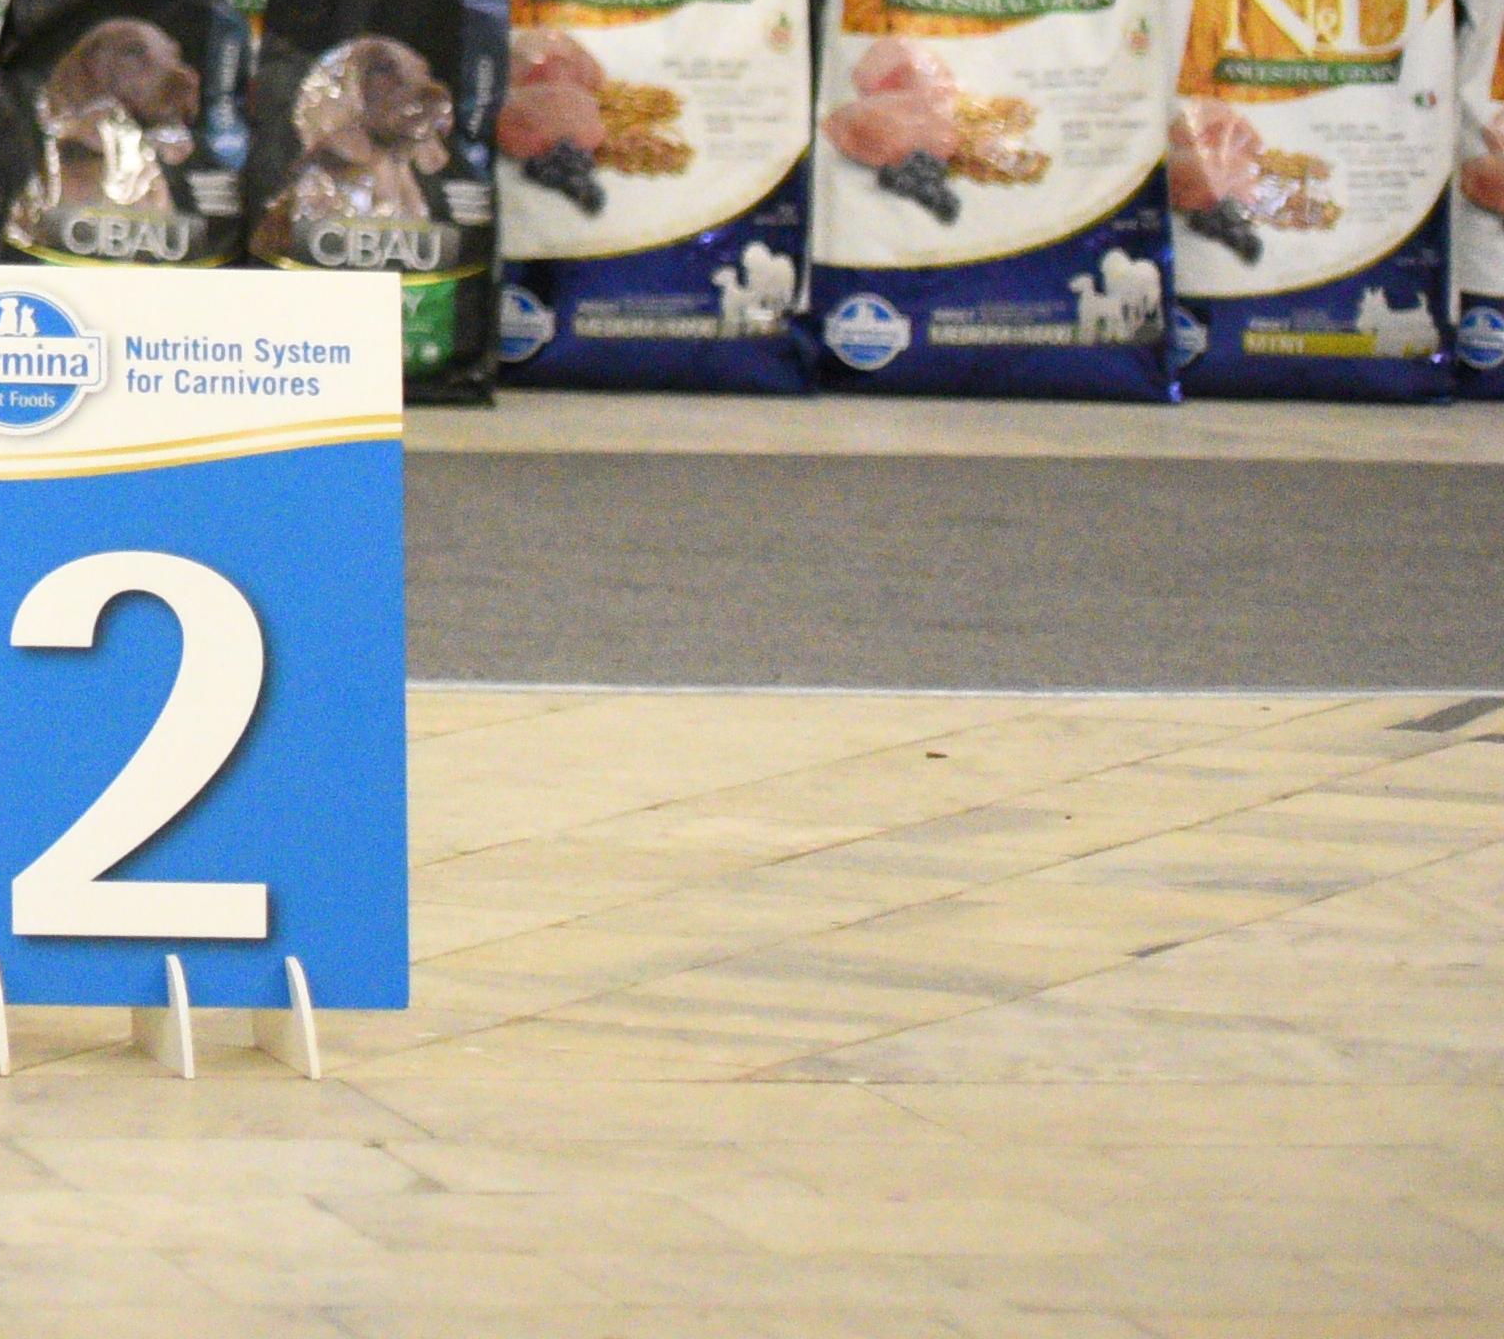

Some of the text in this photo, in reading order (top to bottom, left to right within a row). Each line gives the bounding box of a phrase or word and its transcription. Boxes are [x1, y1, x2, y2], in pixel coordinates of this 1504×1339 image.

[62, 214, 189, 261] CIBAU
[308, 222, 441, 271] CIBAU
[125, 335, 351, 369] Nutrition System
[10, 391, 56, 408] Foods
[126, 368, 320, 397] for Carnivores
[9, 549, 269, 940] 2
